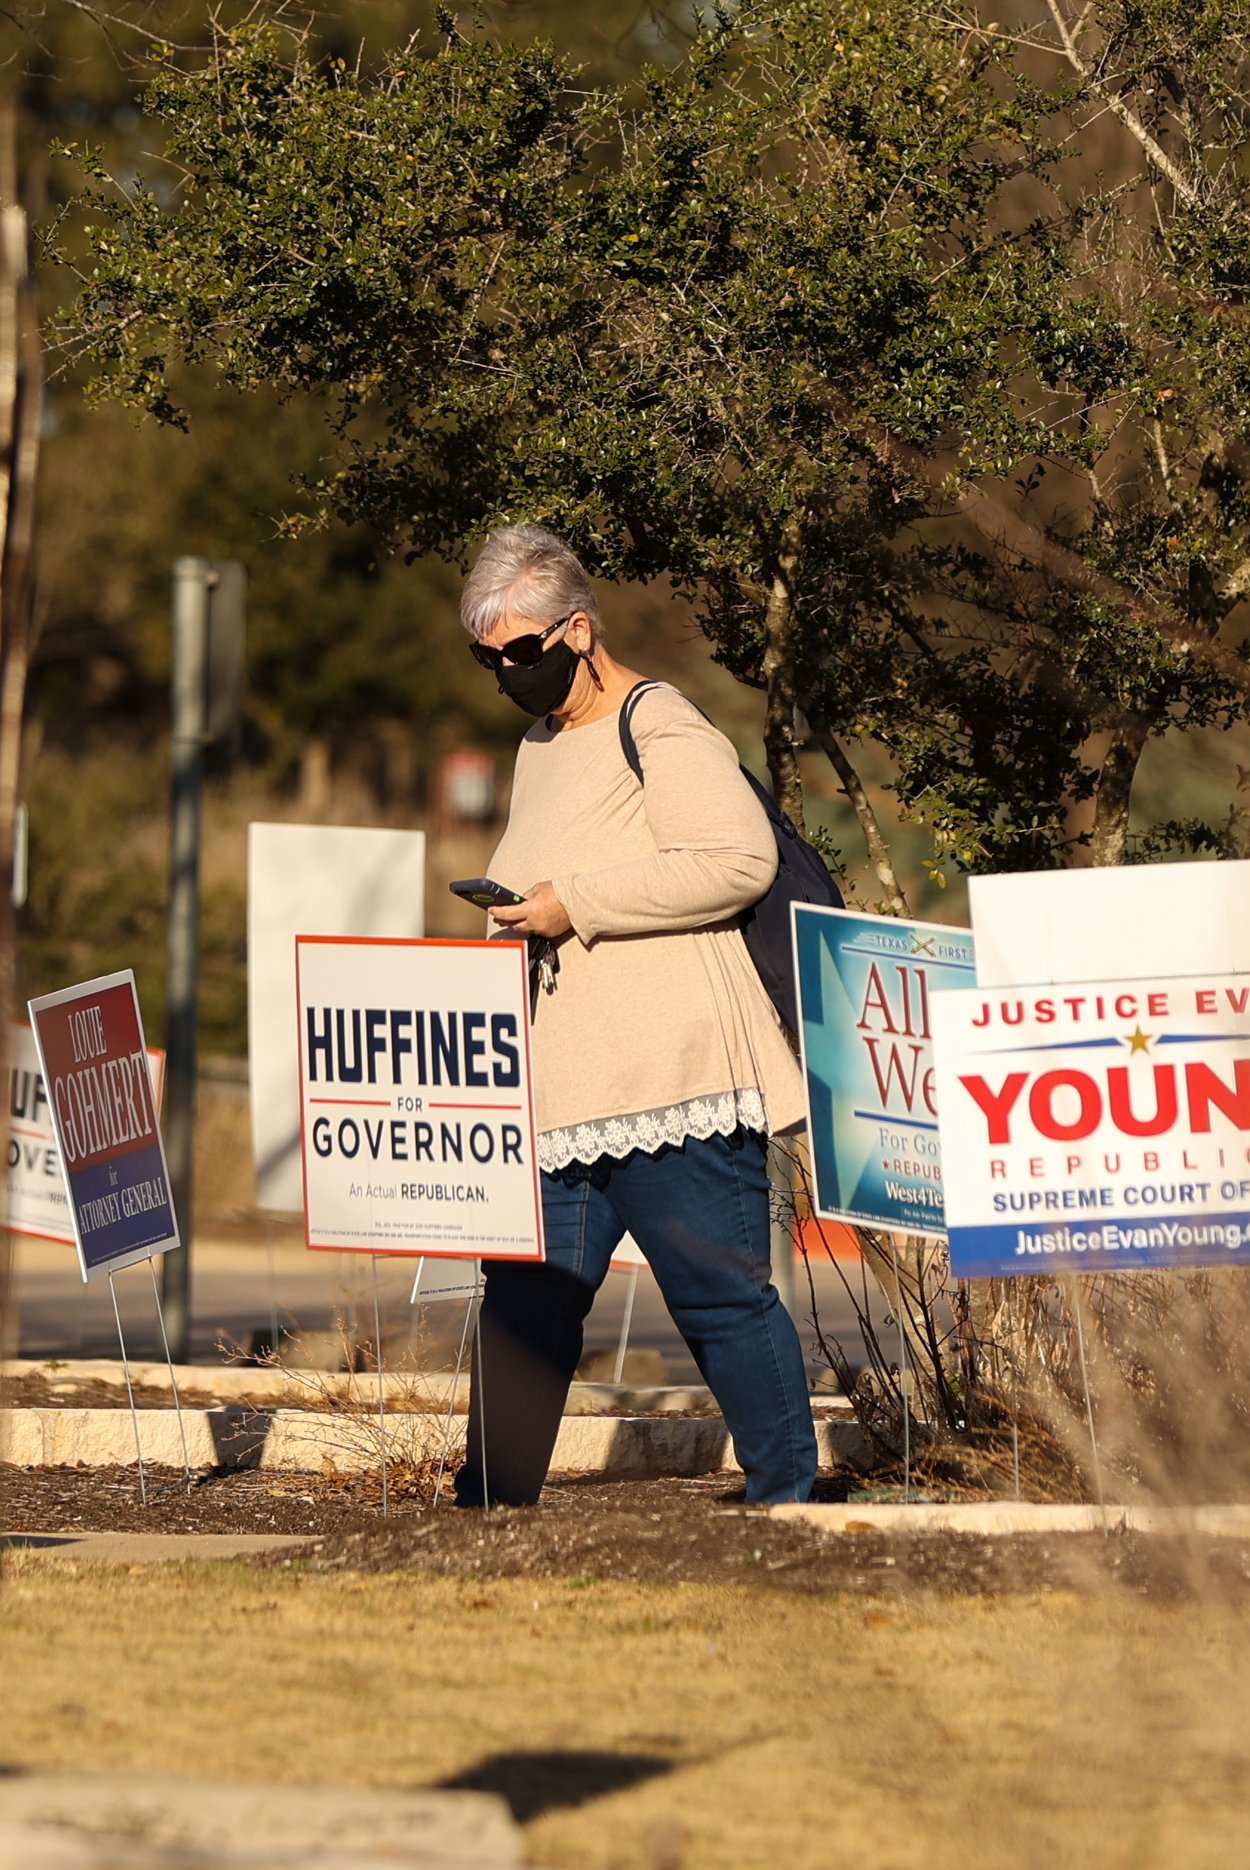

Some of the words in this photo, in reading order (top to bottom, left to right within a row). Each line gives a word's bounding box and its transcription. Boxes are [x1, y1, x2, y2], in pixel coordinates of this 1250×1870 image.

[876, 935, 908, 950] TEXAS
[938, 945, 967, 958] FIRST
[857, 962, 931, 1039] All
[971, 992, 1170, 1028] JUSTICE
[67, 1005, 107, 1063] LOUIE
[306, 1006, 521, 1087] HUFFINES
[863, 1036, 937, 1117] We
[55, 1050, 153, 1164] GOHMERT
[397, 1096, 424, 1112] FOR
[313, 1117, 525, 1165] GOVERNOR
[879, 1127, 908, 1151] For
[914, 1133, 941, 1156] Go
[108, 1166, 119, 1185] for
[893, 1159, 941, 1180] REPUB
[79, 1191, 121, 1235] ATTORNEY
[121, 1176, 168, 1219] GENERAL
[349, 1183, 363, 1199] An
[366, 1183, 398, 1200] Actual
[401, 1183, 490, 1203] REPUBLICAN.
[885, 1180, 944, 1207] West4Te
[993, 1187, 1114, 1212] SUPREME
[1123, 1183, 1210, 1207] COURT
